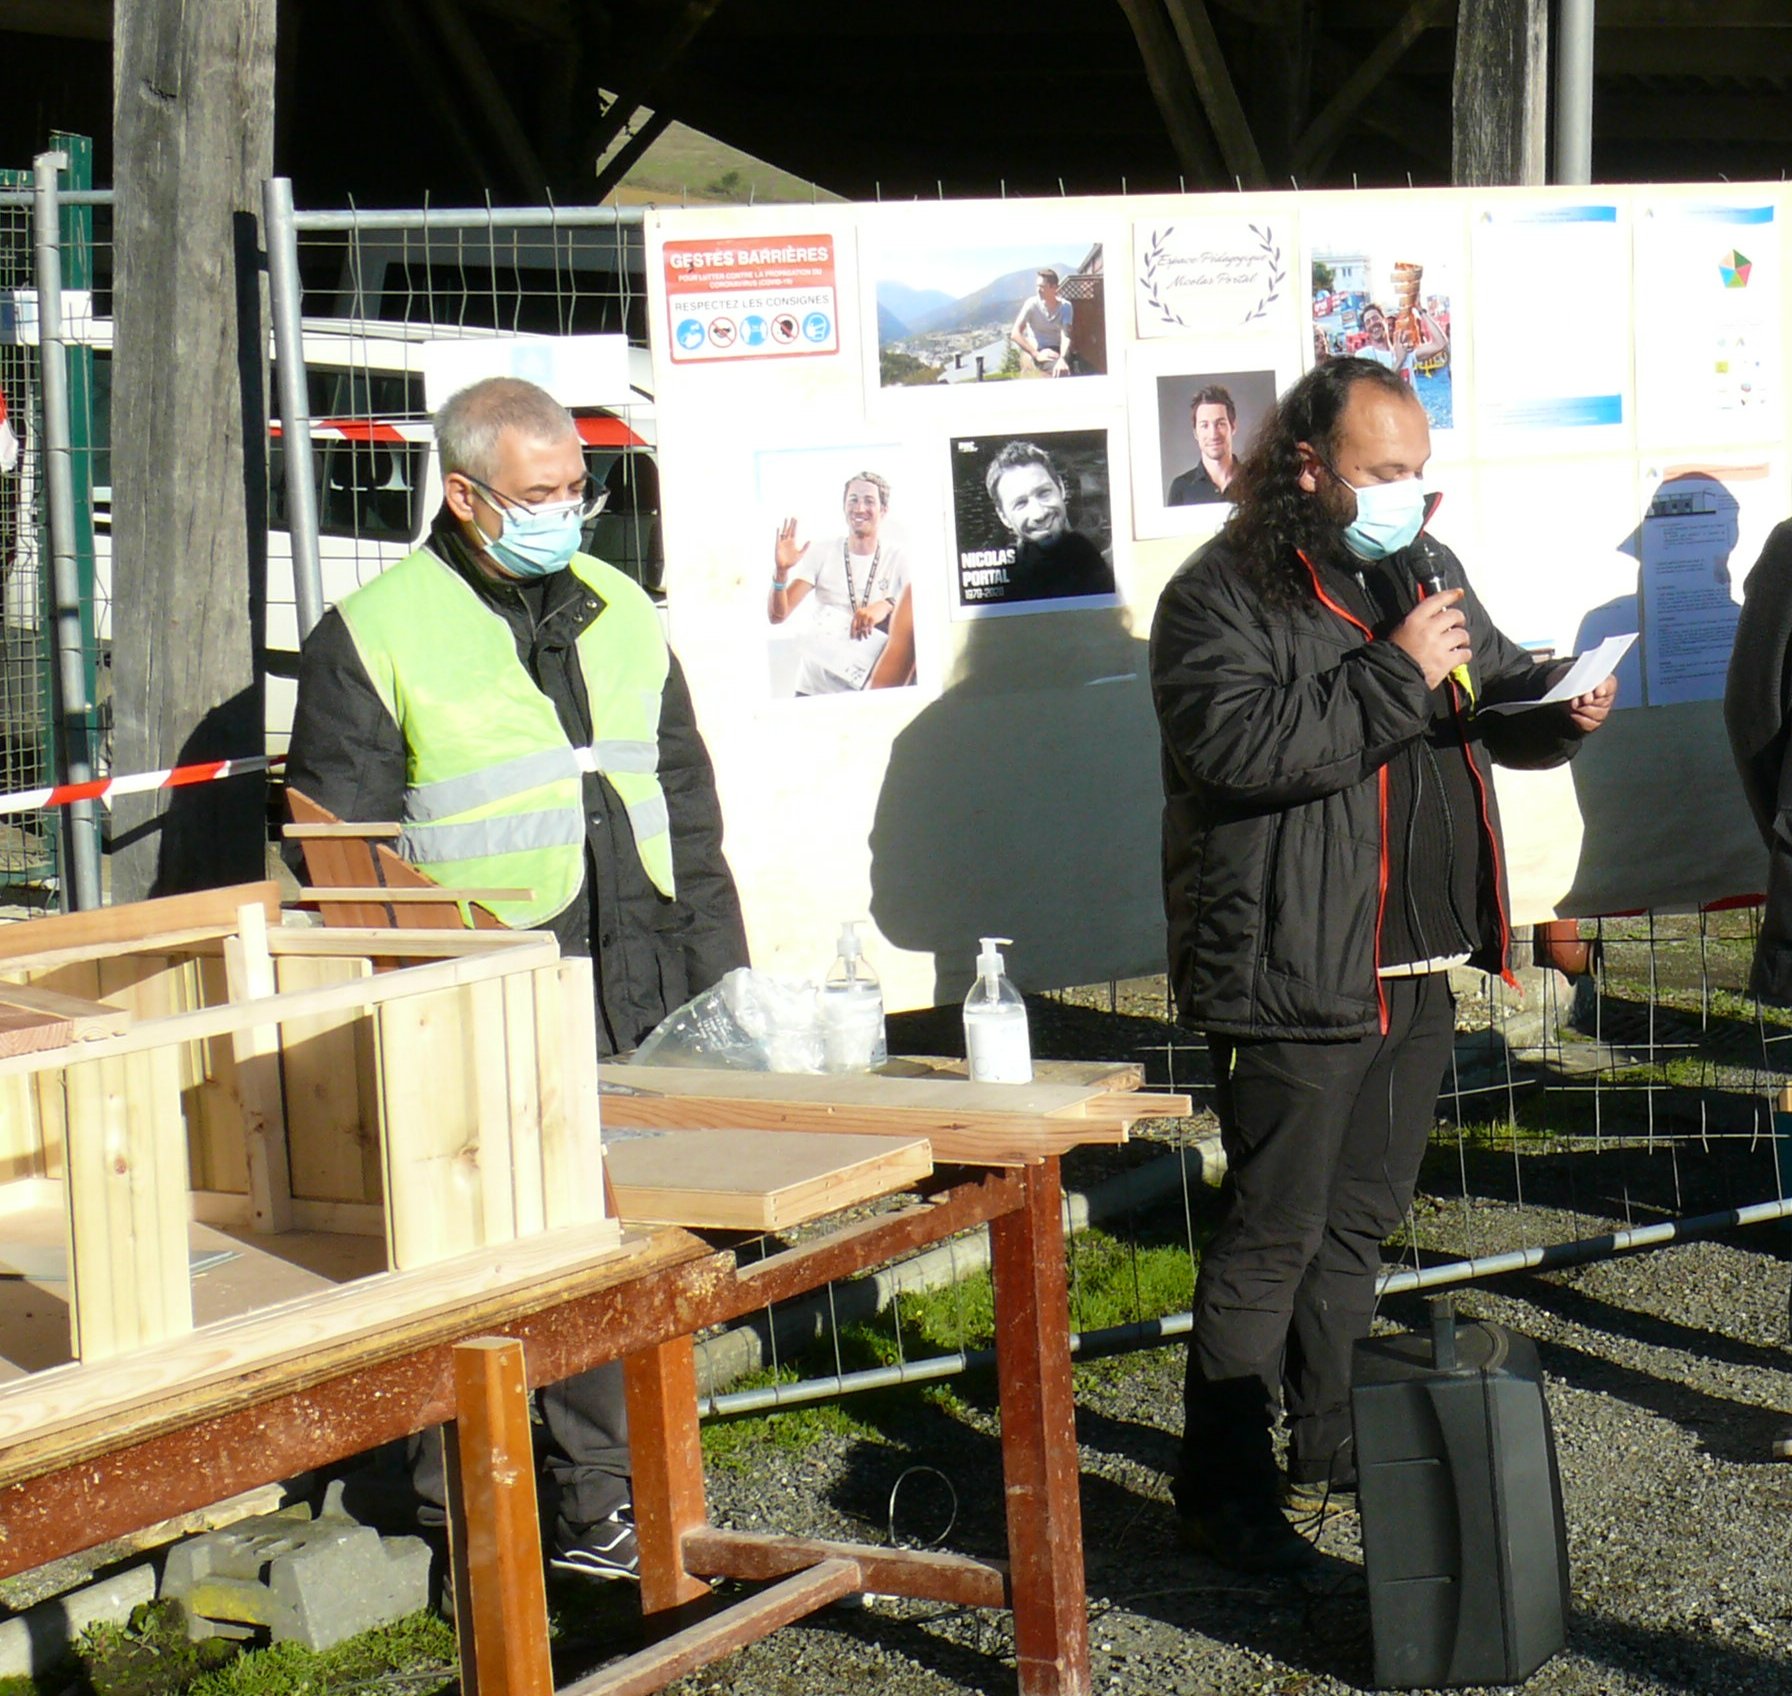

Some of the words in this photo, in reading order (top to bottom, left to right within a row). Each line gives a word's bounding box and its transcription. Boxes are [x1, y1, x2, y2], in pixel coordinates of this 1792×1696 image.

[670, 251, 734, 268] GESTES
[738, 245, 829, 265] BARRIÈRES
[674, 299, 738, 312] RESPECTEZ
[742, 297, 762, 309] LES
[766, 295, 829, 308] CONSIGNES
[961, 549, 1016, 569] NICOLAS
[962, 569, 1010, 588] PORTAL
